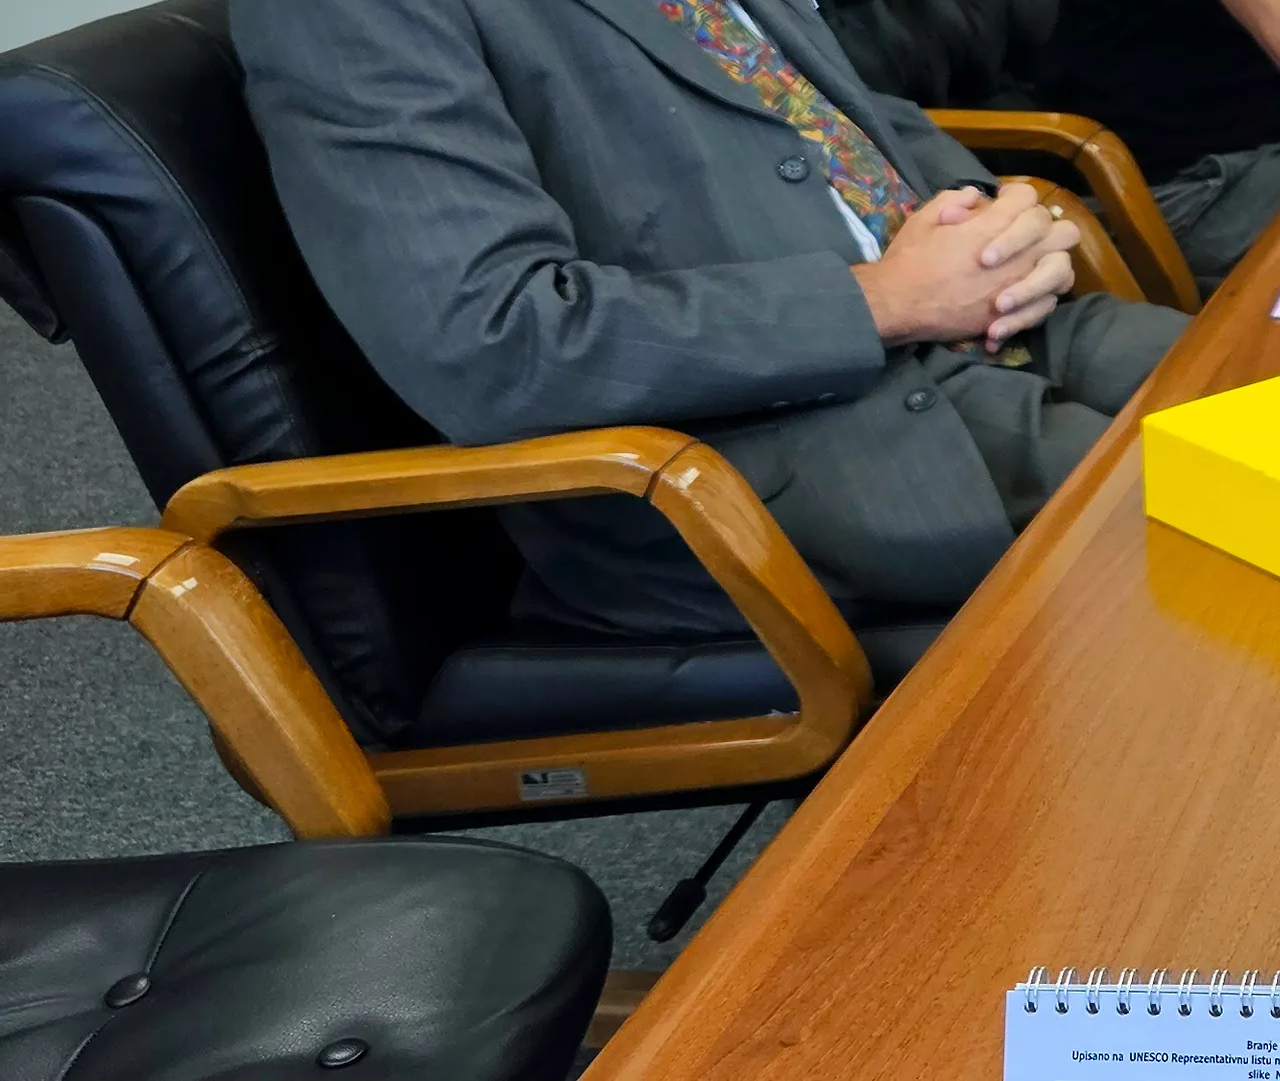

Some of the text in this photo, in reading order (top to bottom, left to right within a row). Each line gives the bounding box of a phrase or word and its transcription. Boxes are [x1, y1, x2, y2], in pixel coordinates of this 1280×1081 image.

[1247, 1040, 1278, 1053] Branje
[1072, 1050, 1110, 1063] Upisano
[1112, 1053, 1124, 1061] na
[1129, 1052, 1169, 1062] UNESCO
[1171, 1052, 1249, 1065] Reprezentativnu
[1251, 1055, 1272, 1065] listu
[1248, 1070, 1271, 1081] slike
